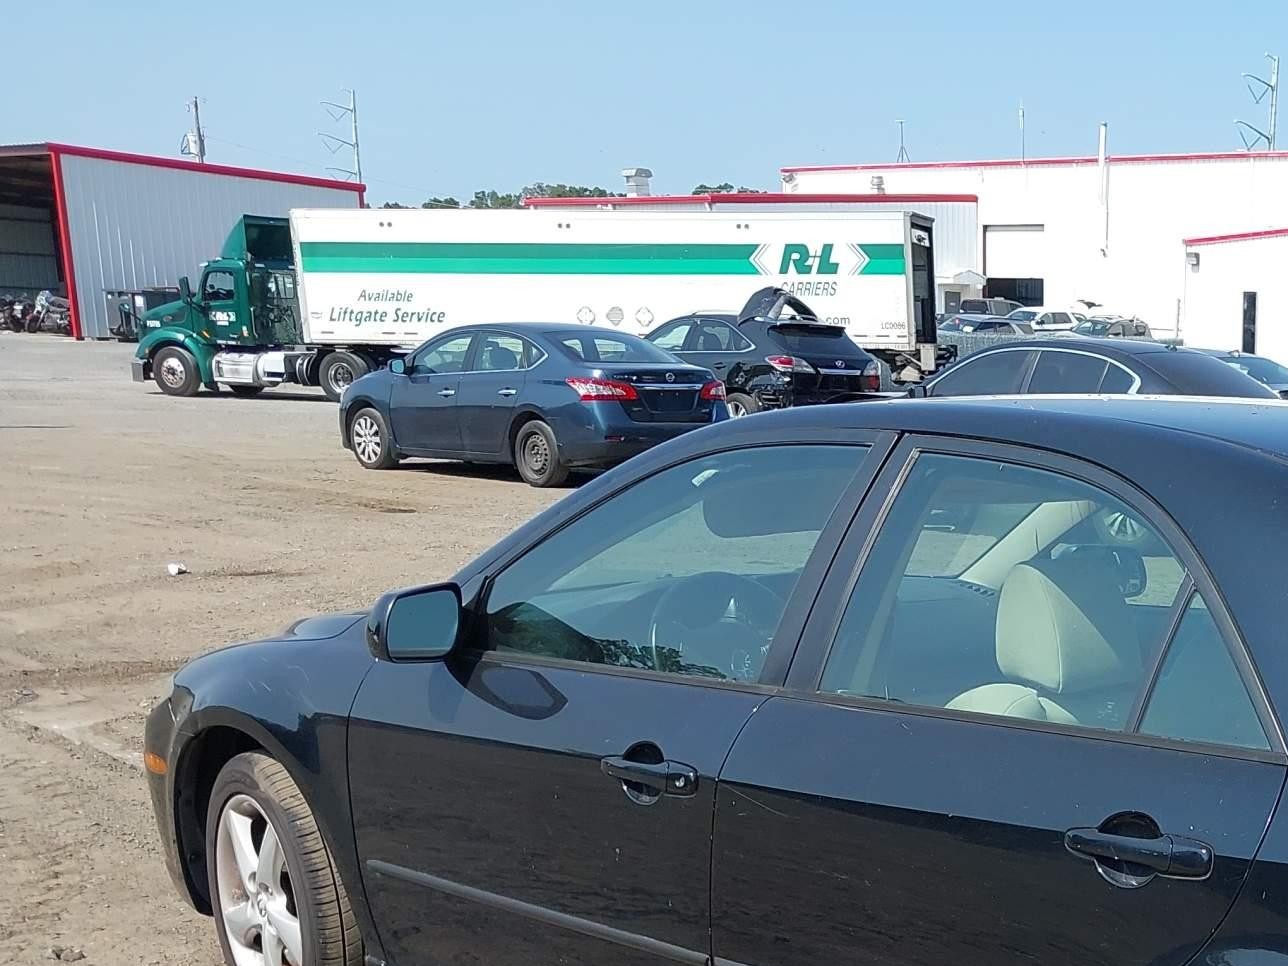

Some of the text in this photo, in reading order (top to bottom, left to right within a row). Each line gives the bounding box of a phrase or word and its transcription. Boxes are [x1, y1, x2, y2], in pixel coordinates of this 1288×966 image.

[357, 289, 414, 302] Available
[781, 281, 838, 297] CARRIERS
[329, 306, 446, 327] Liftgate Service
